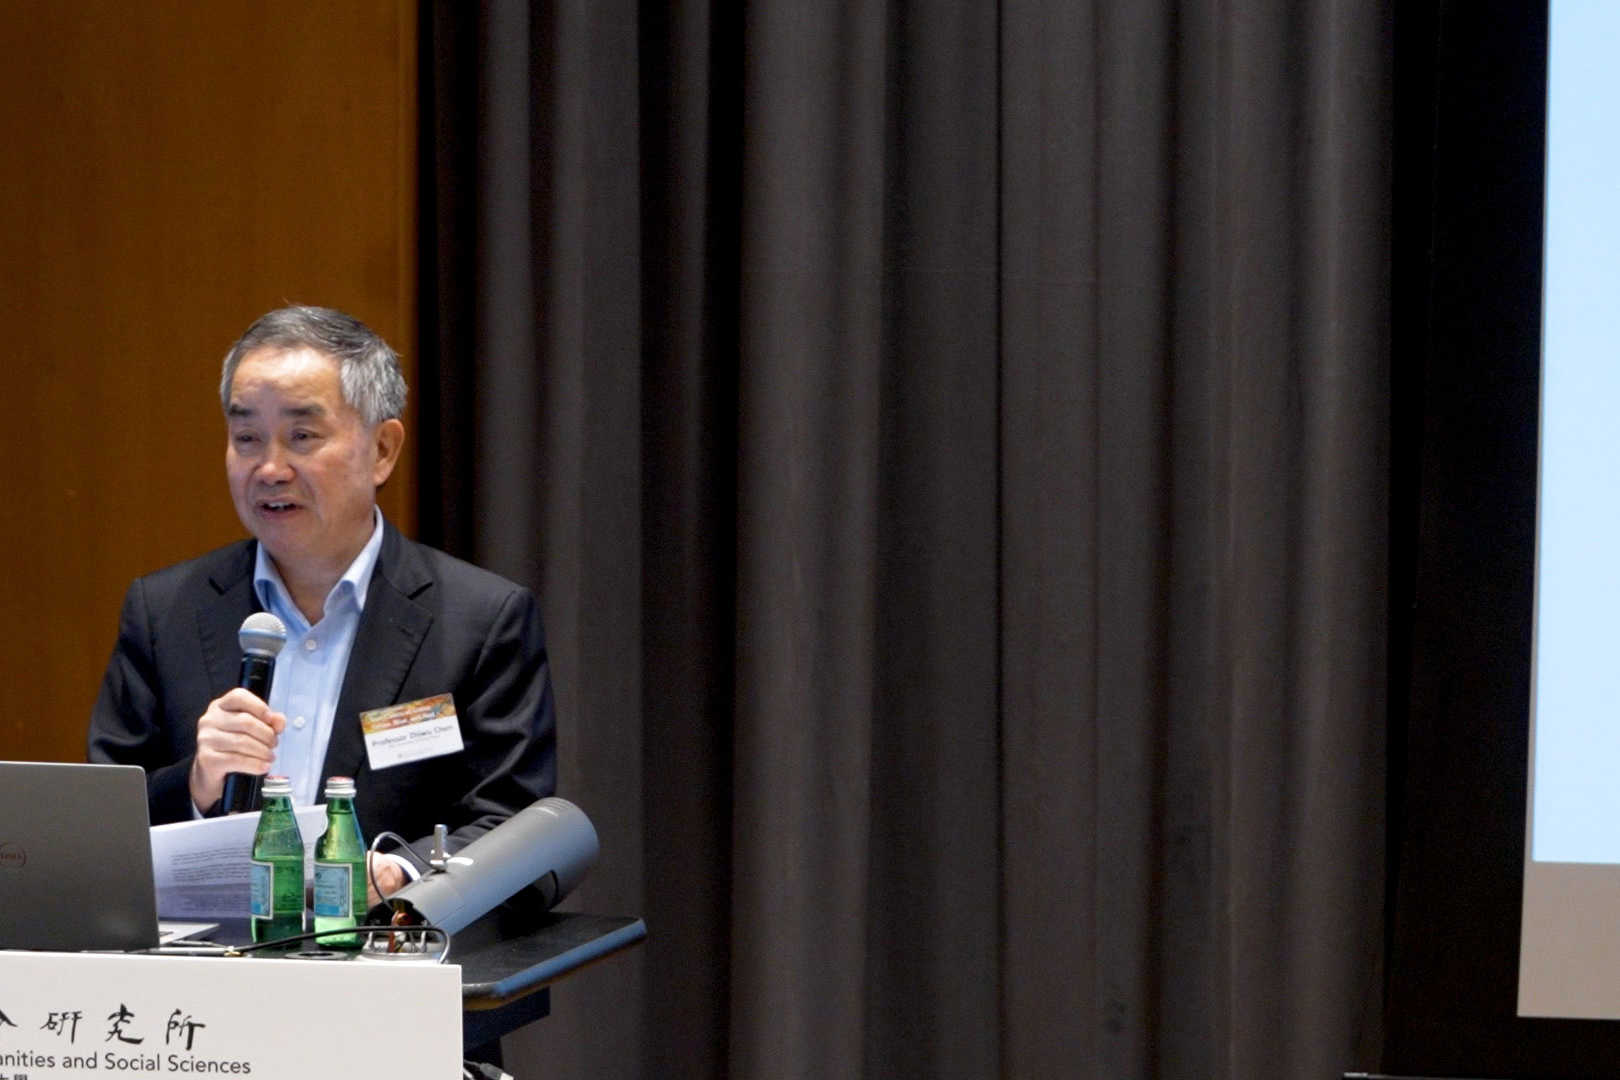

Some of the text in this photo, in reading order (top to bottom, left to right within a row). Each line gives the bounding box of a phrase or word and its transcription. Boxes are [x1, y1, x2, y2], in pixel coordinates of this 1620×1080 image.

[371, 734, 408, 747] Professor
[434, 724, 454, 733] Chen
[62, 1051, 98, 1070] and
[104, 1053, 161, 1071] Social
[167, 1055, 251, 1074] Sciences
